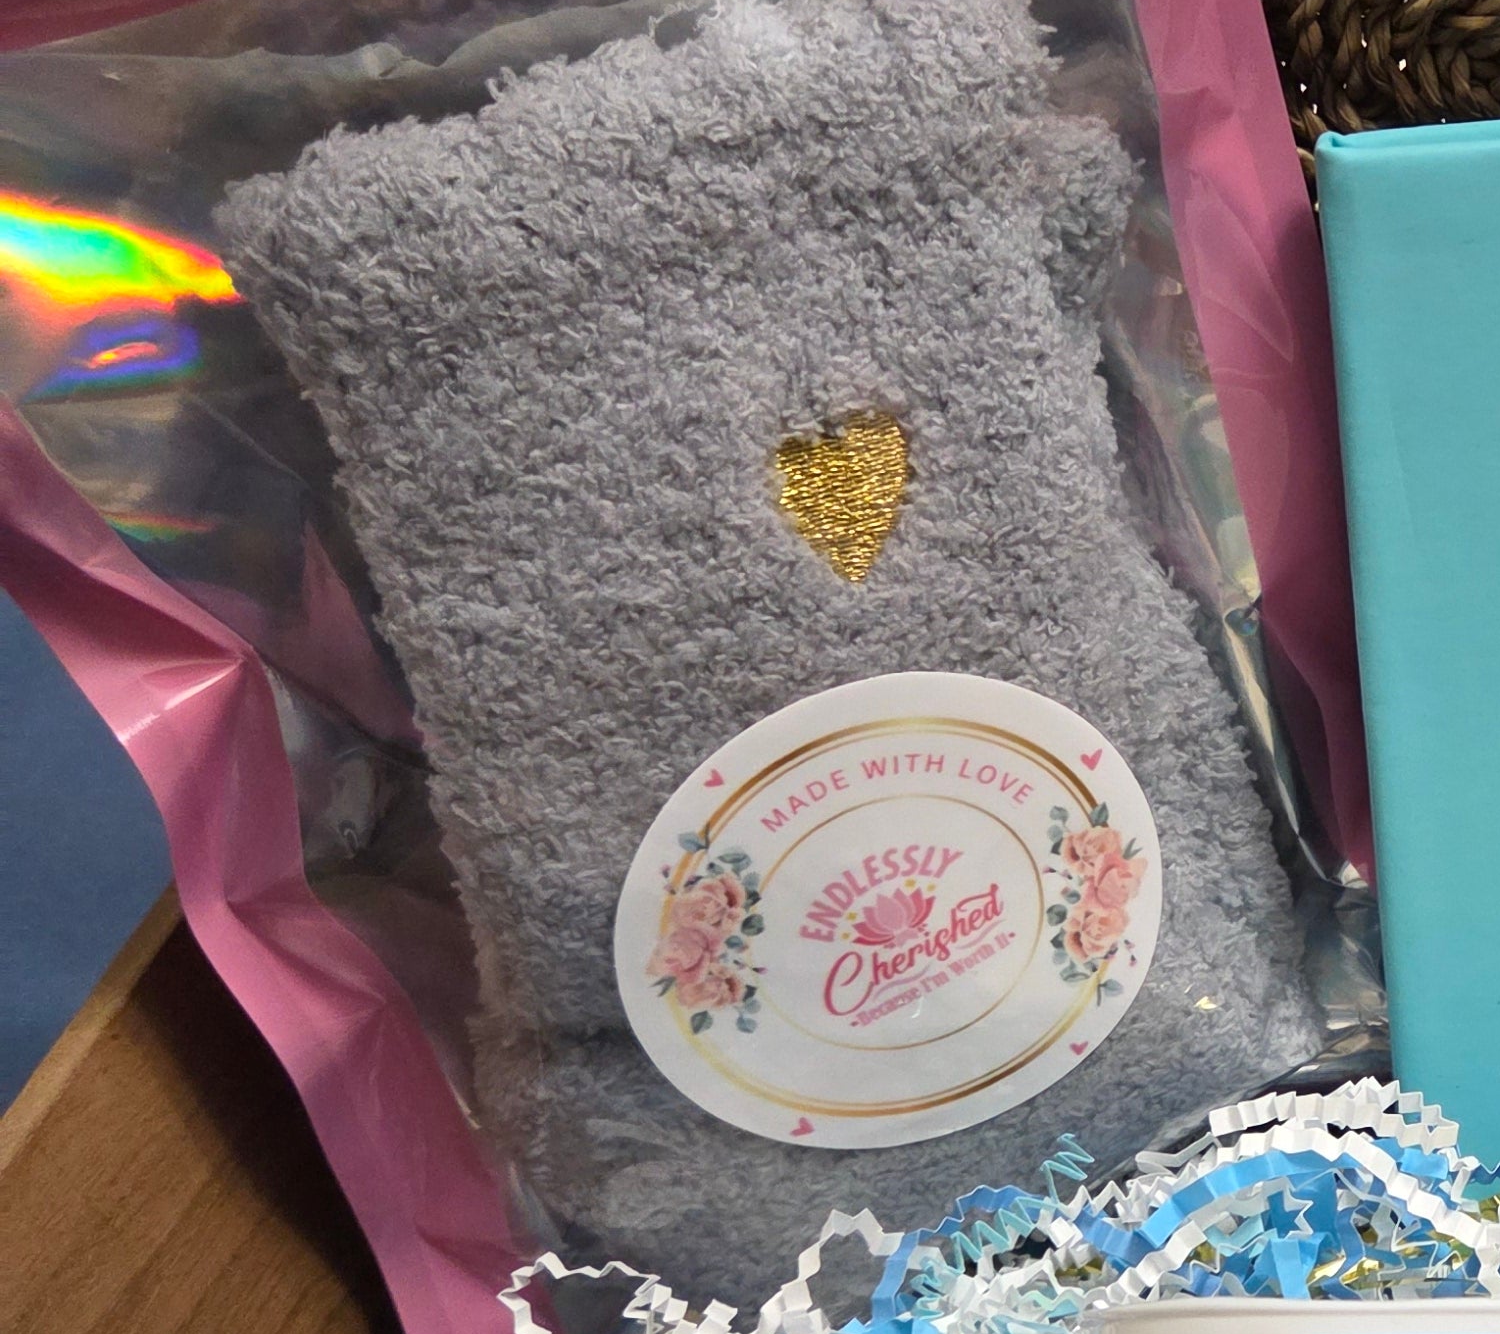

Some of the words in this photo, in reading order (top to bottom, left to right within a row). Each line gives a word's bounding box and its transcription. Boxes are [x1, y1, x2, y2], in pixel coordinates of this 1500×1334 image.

[760, 769, 850, 833] MADE
[860, 754, 945, 779] WITH
[958, 758, 1035, 804] LOVE
[799, 844, 964, 943] ENDLESSLY
[823, 883, 1004, 1016] Cherished
